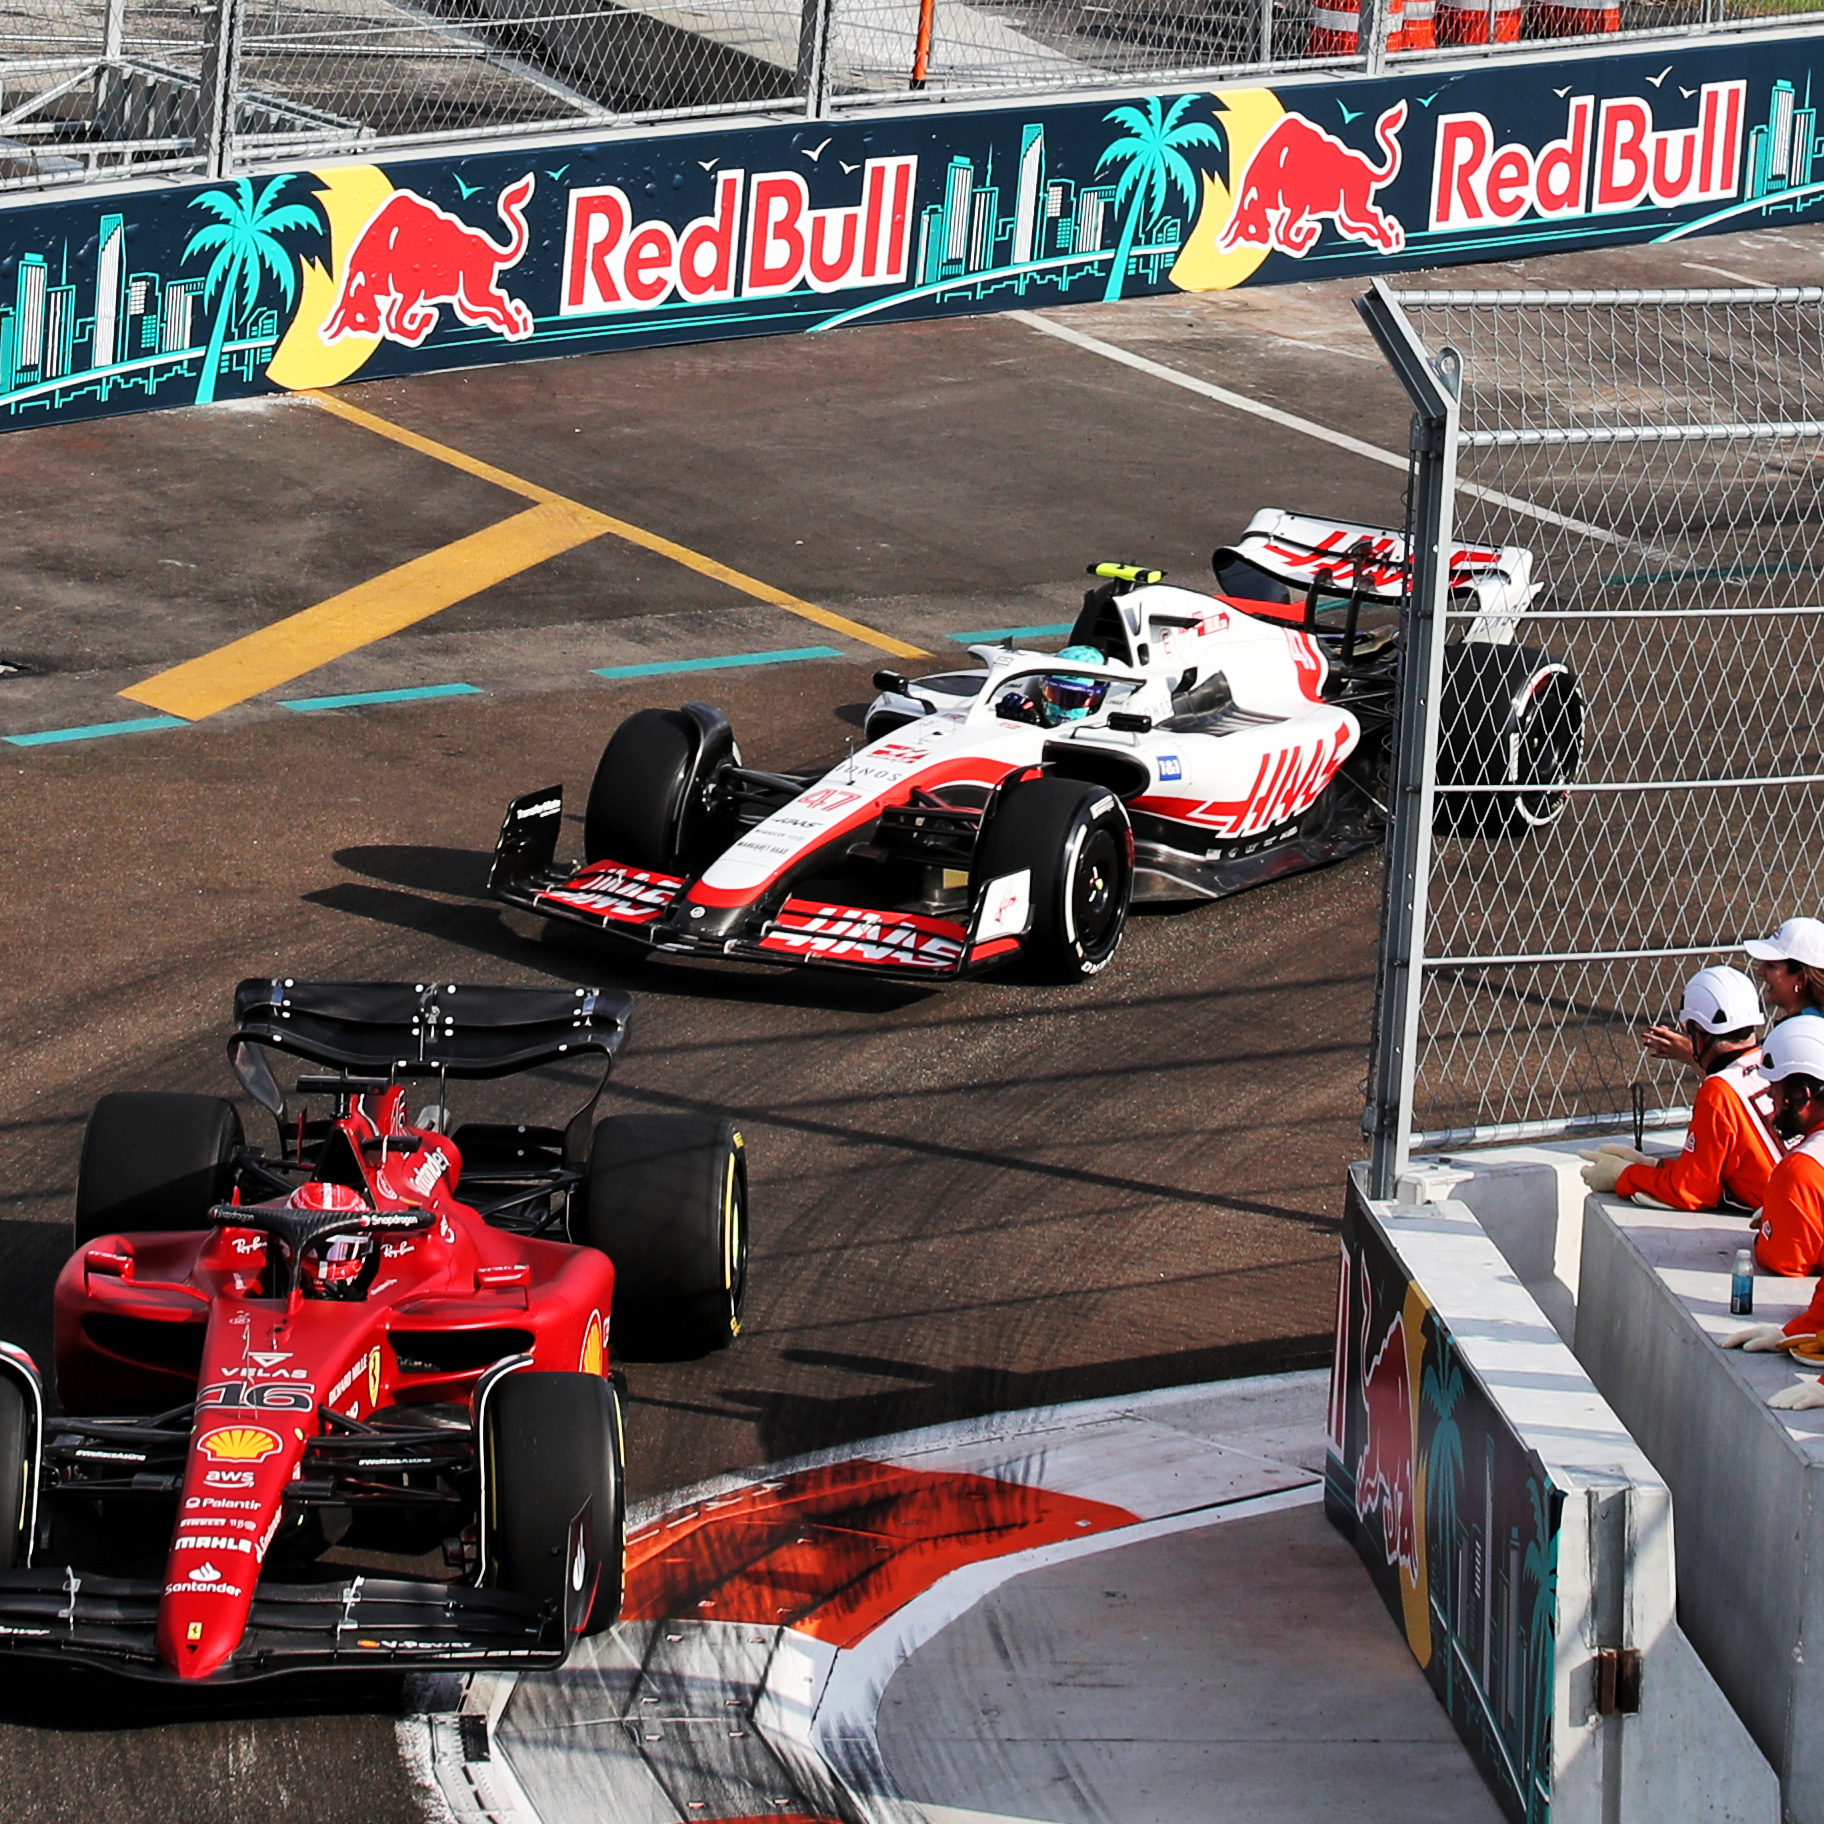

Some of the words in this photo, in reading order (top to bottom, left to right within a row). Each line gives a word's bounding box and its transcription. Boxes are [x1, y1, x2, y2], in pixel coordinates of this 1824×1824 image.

[1428, 96, 1595, 231] Red
[1597, 81, 1748, 215] Bull
[560, 169, 739, 316] Red
[741, 154, 918, 302] Bull
[834, 763, 903, 782] IONOS
[797, 789, 862, 811] 47
[371, 1214, 418, 1227] Snapdragon
[221, 1367, 308, 1379] VELAS
[194, 1381, 315, 1414] 16
[206, 1470, 254, 1482] aws
[202, 1497, 262, 1510] Palantir
[175, 1536, 252, 1553] MAHLE
[164, 1581, 242, 1597] Santander
